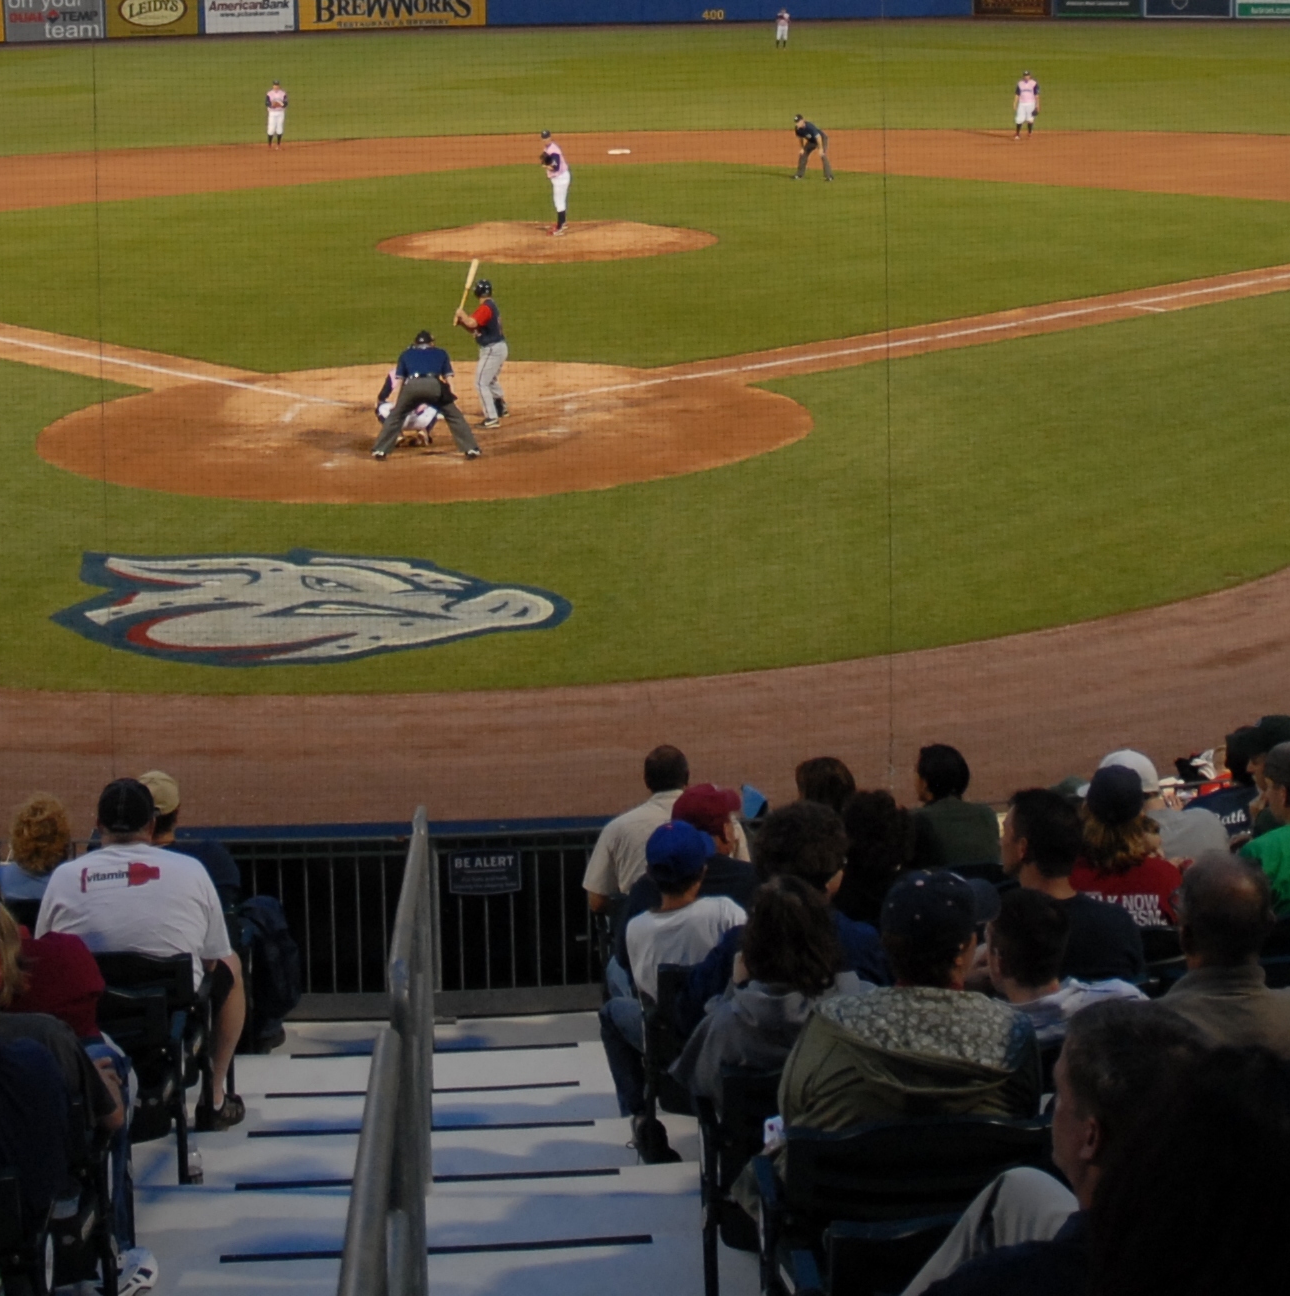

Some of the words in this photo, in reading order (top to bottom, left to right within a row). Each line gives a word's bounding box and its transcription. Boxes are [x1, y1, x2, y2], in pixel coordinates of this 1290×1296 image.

[10, 12, 47, 23] DUAL
[59, 10, 99, 22] TEMP
[45, 21, 100, 39] team
[454, 857, 471, 869] BE
[474, 855, 514, 868] ALERT
[87, 870, 130, 883] vitamin
[1122, 894, 1160, 912] NOW
